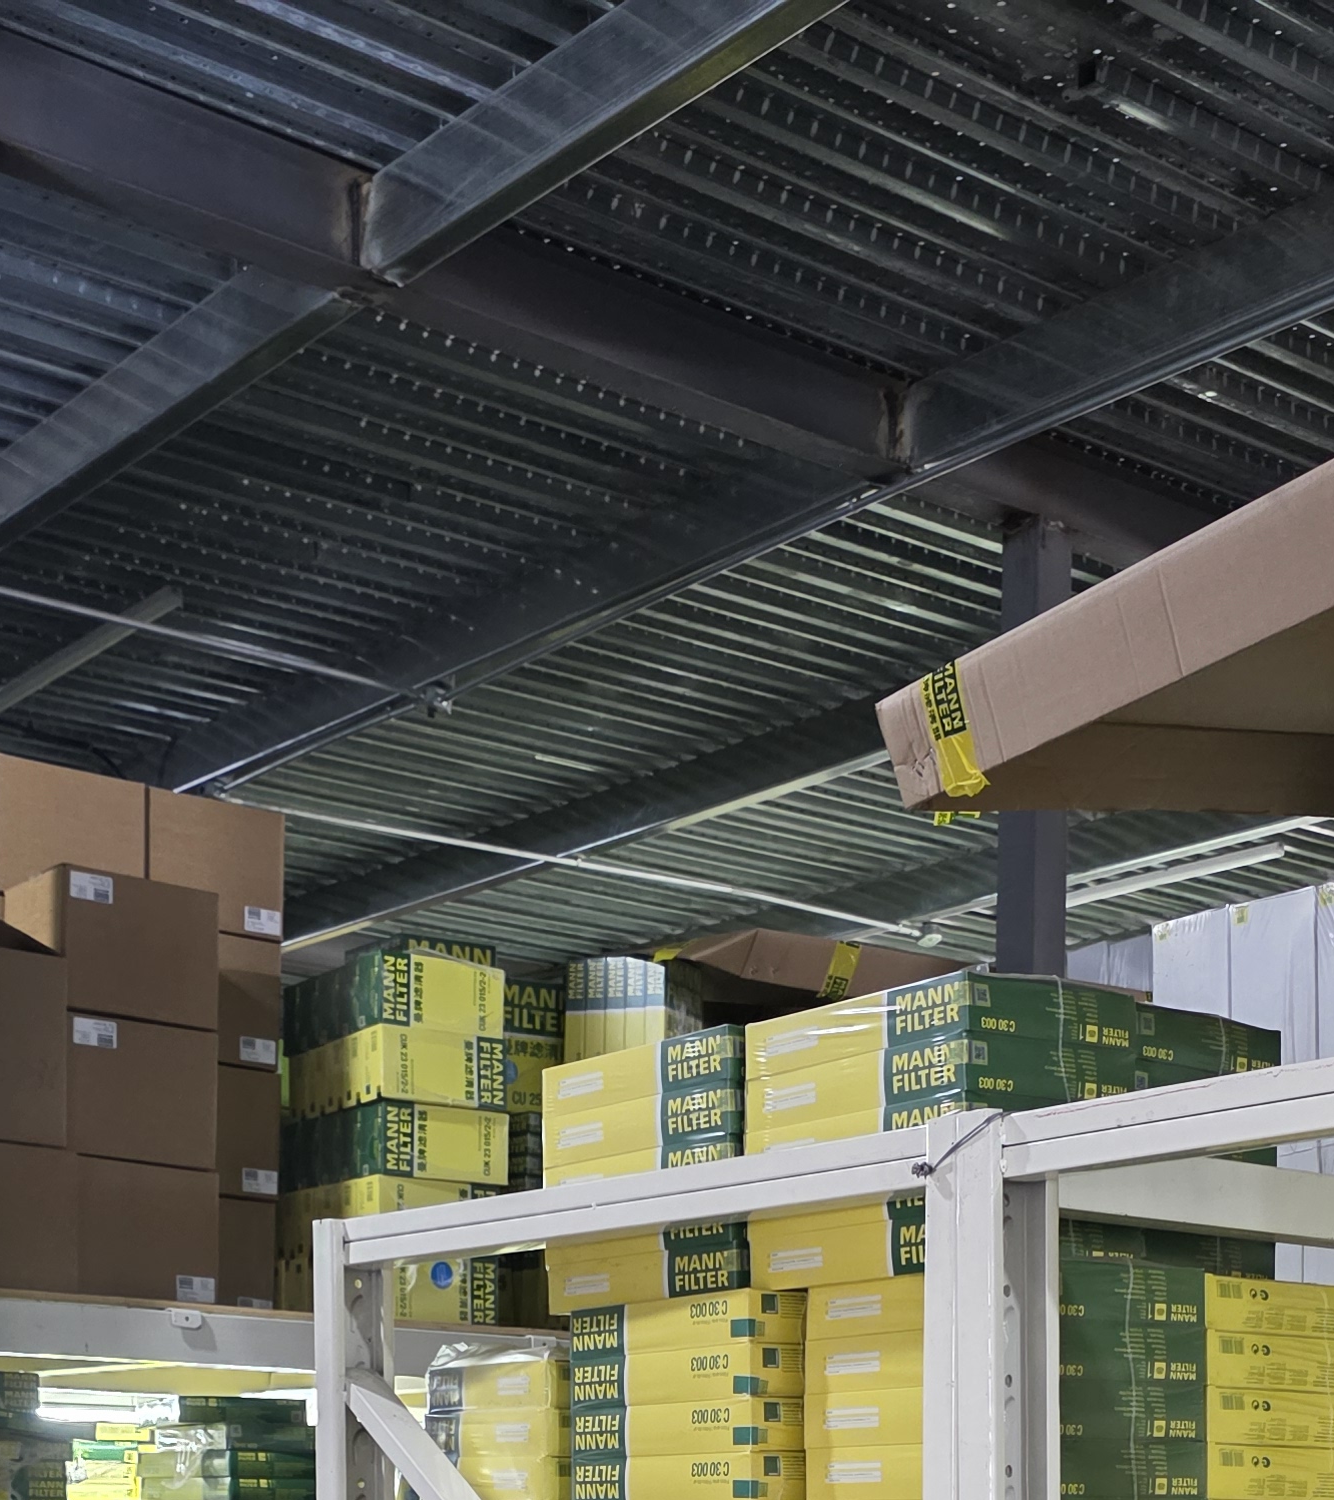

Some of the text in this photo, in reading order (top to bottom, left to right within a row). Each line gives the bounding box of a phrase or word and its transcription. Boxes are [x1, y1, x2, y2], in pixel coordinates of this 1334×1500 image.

[383, 955, 395, 1020] MANN
[396, 957, 408, 1021] FILTER
[896, 982, 959, 1013] MANN
[896, 1005, 959, 1035] FILTER
[668, 1036, 720, 1063] MANN
[480, 1041, 491, 1104] FILTER
[492, 1043, 504, 1105] MANN
[669, 1056, 721, 1081] FILTER
[690, 1300, 727, 1318] C 30 003
[1171, 1304, 1197, 1313] FILTER
[1171, 1313, 1197, 1322] MANN
[574, 1313, 617, 1333] FILTER
[573, 1332, 617, 1352] MANN
[692, 1408, 730, 1424] C 30 003
